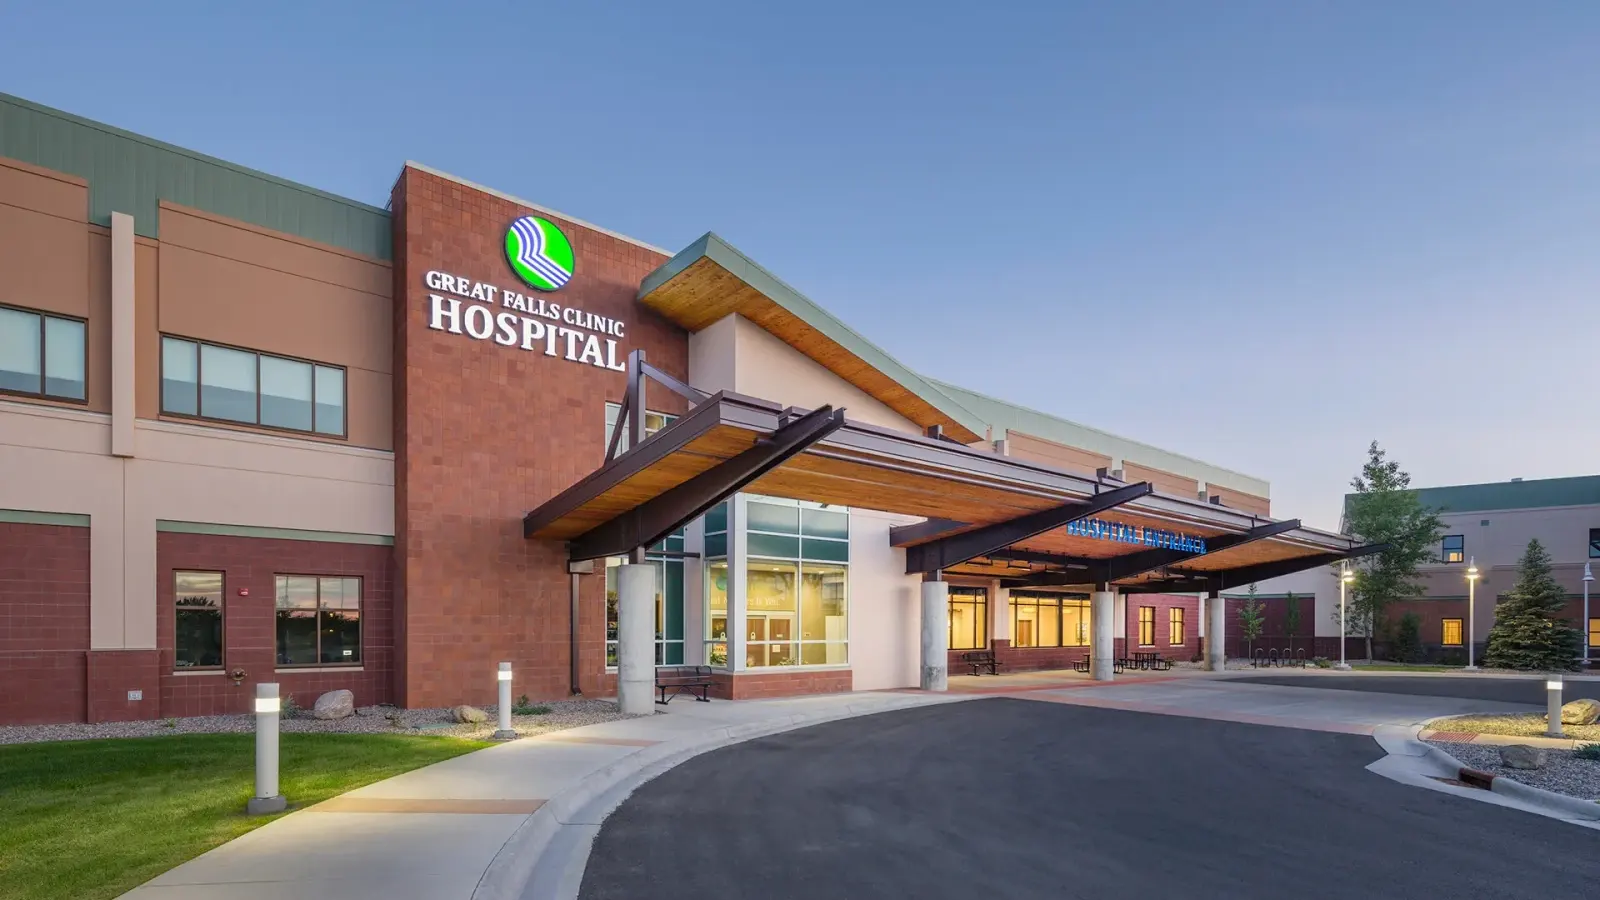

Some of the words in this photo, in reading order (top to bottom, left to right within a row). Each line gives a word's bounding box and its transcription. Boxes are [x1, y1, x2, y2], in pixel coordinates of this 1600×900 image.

[426, 270, 497, 302] GREAT
[503, 290, 560, 320] FALLS
[563, 307, 624, 337] CLINIC
[429, 294, 625, 371] HOSPITAL
[1067, 517, 1139, 544] HOSPITAL
[1143, 527, 1206, 554] ENTRANCE
